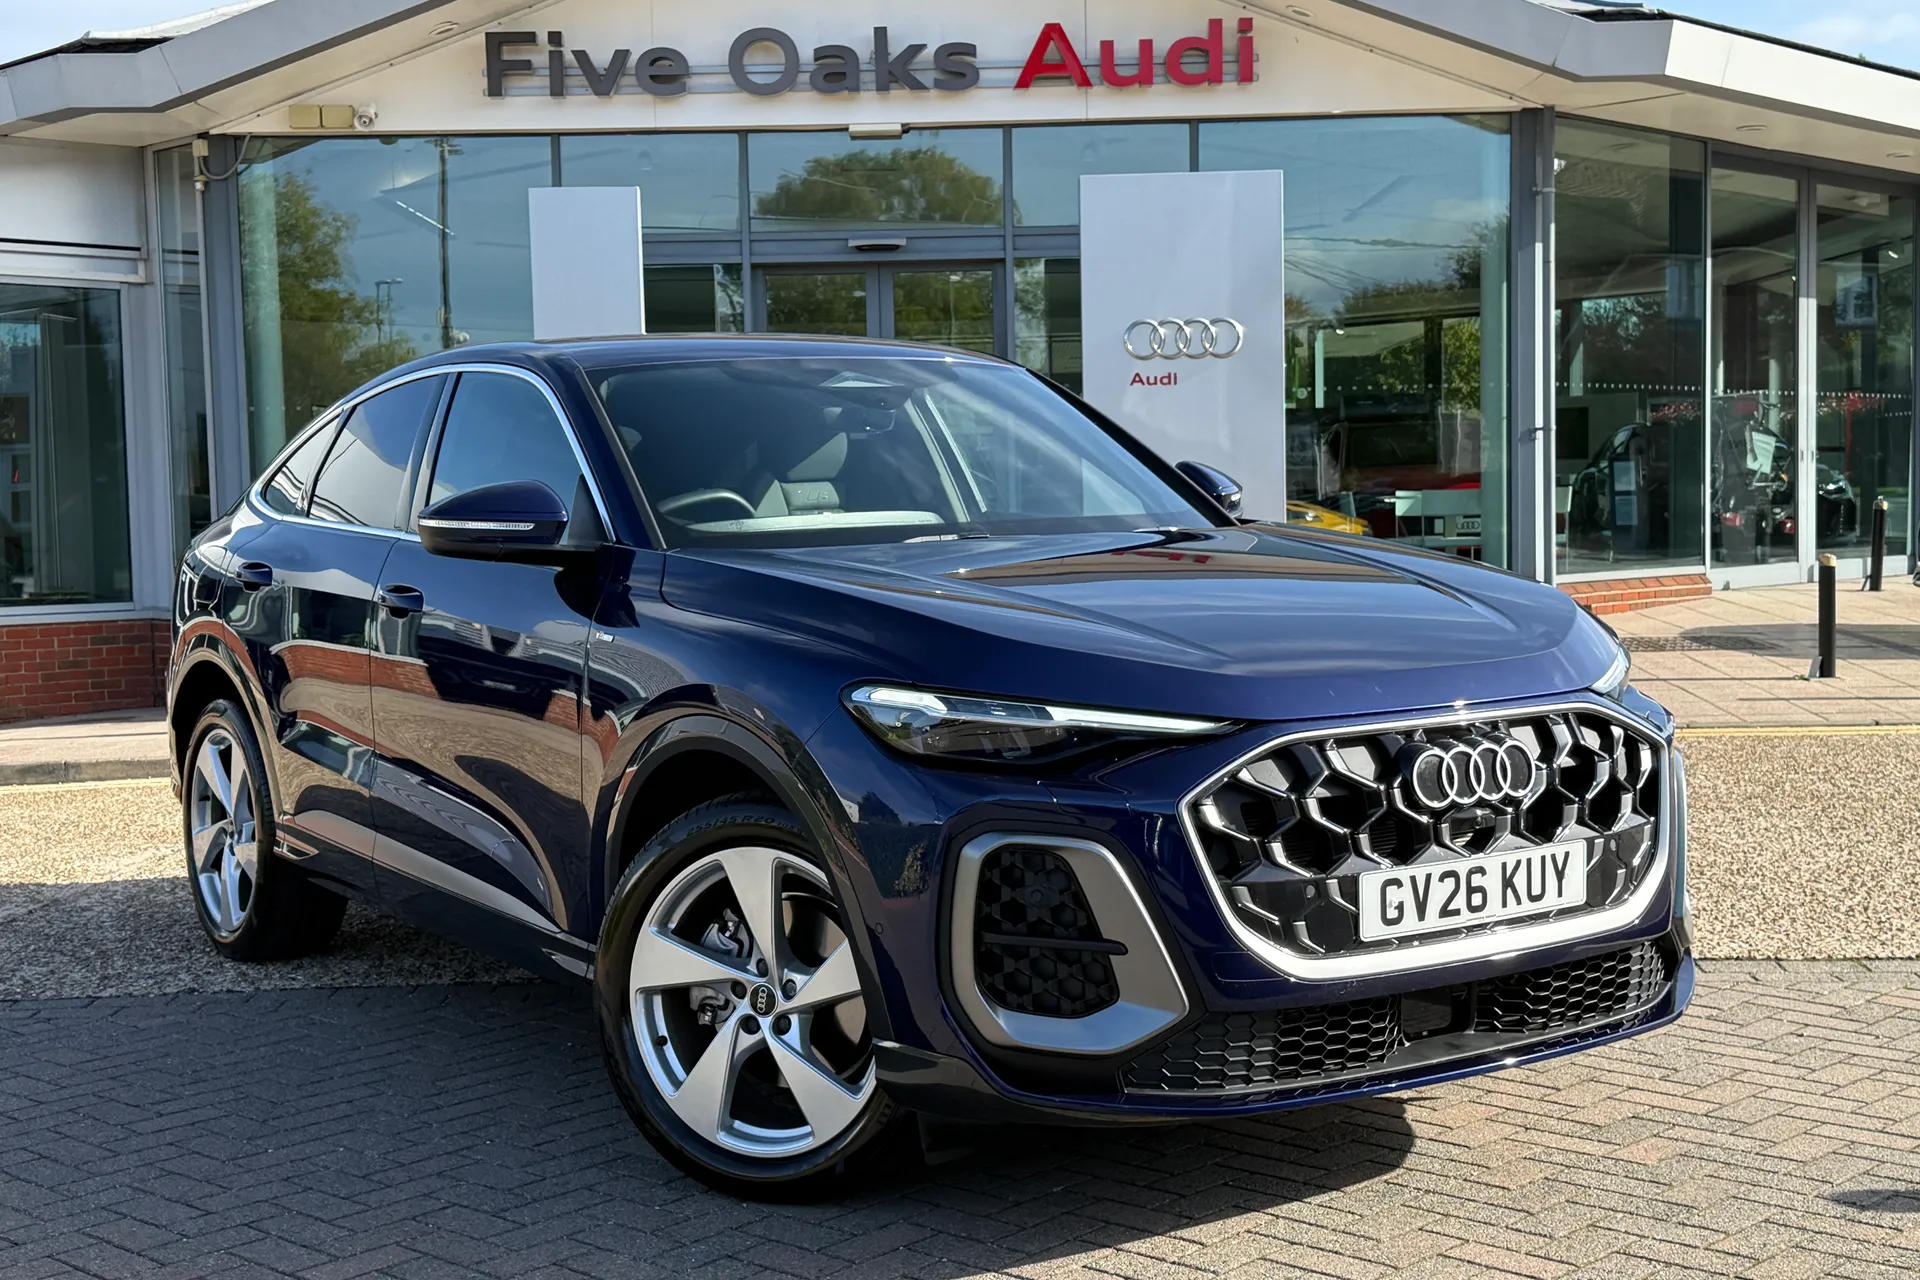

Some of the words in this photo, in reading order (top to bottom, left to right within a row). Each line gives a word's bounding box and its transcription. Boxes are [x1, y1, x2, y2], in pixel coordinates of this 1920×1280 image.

[485, 30, 691, 97] Five
[728, 26, 980, 95] Oaks
[1014, 17, 1254, 89] Audi
[1129, 372, 1178, 386] Audi
[1380, 865, 1488, 927] GV26
[1501, 850, 1570, 909] KUY
